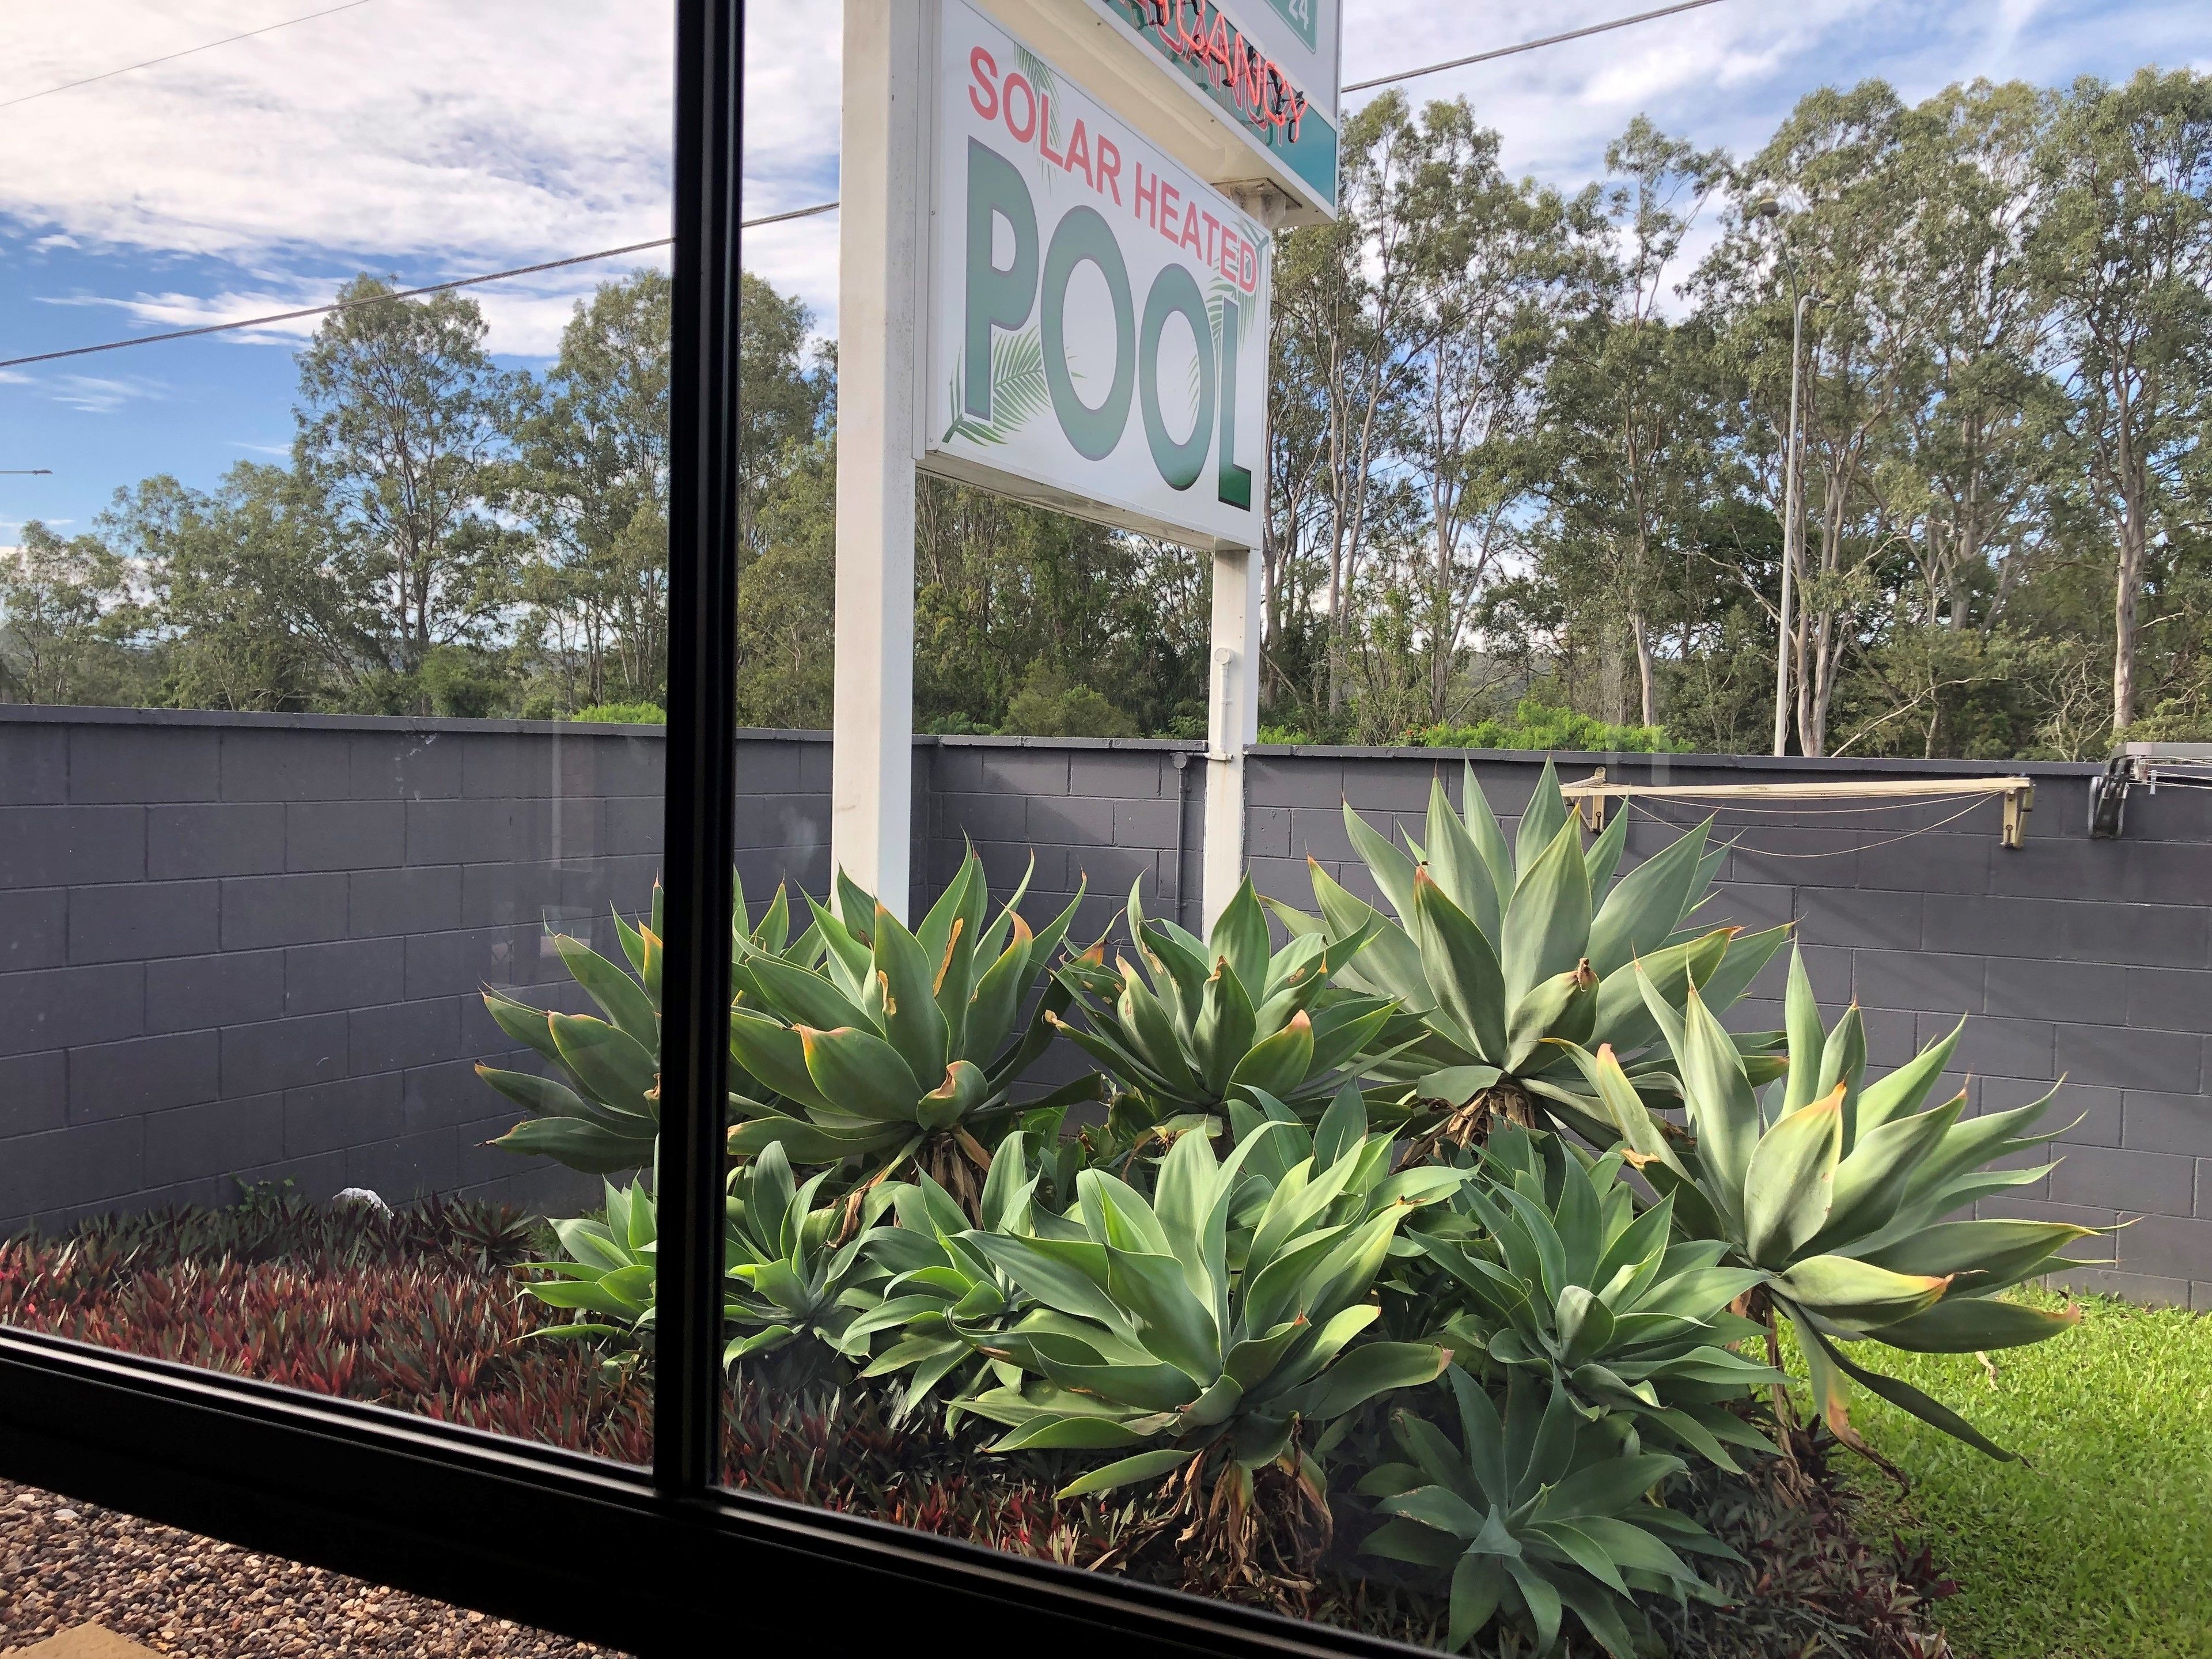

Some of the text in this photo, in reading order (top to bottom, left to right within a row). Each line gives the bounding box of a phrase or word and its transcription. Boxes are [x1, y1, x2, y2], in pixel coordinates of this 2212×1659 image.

[964, 134, 1252, 513] POOL
[968, 46, 1257, 293] SOLAR HEATED
